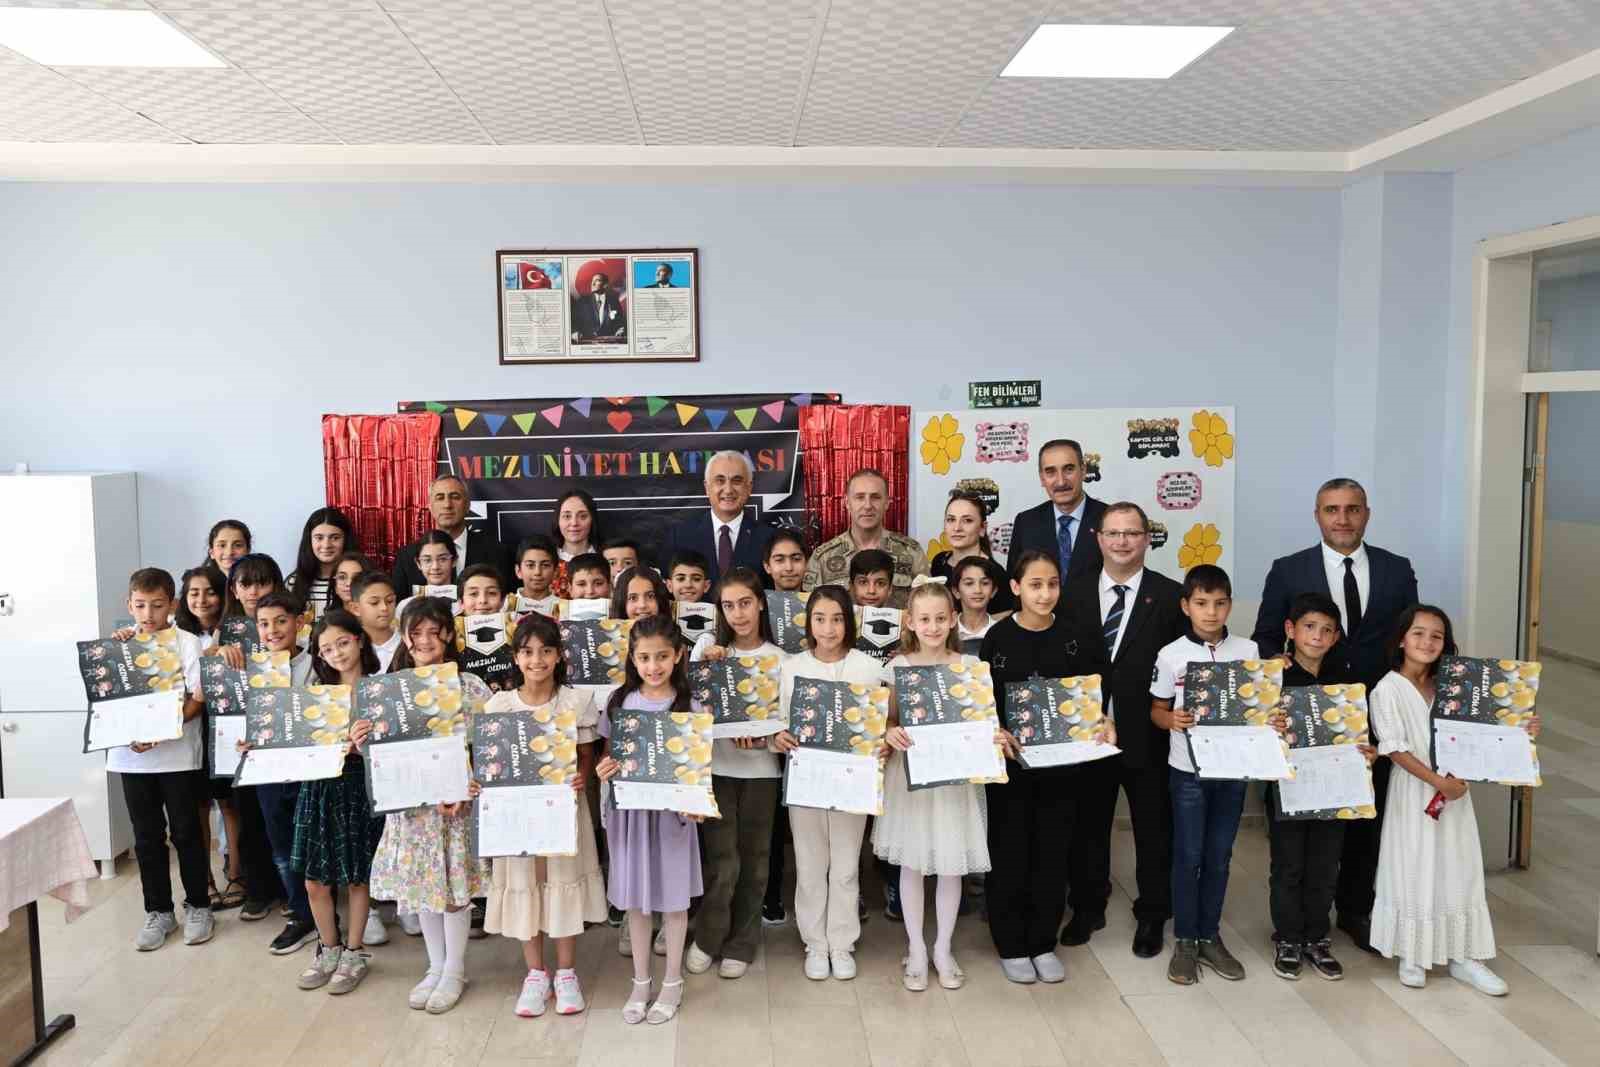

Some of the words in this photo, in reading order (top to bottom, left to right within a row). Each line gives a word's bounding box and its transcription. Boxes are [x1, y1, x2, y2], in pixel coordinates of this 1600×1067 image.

[974, 386, 990, 397] FEN
[992, 383, 1037, 396] BİLİMLERİ
[458, 447, 632, 478] MEZUNİYET
[639, 449, 785, 475] HATASI
[120, 642, 136, 671] MEZUN
[584, 627, 598, 660] MEZUN
[466, 656, 497, 669] MEZUN
[240, 670, 250, 692] EZUN
[398, 677, 415, 711] MEZUN
[725, 664, 737, 697] MEZUN
[935, 671, 950, 701] MEZUN
[1228, 668, 1237, 700] MEZUN
[1482, 665, 1491, 698] MEZUN
[292, 692, 302, 722] MEZUN
[834, 688, 843, 724] MEZUN
[1046, 686, 1059, 719] MEZUN
[1471, 686, 1480, 717] OLDUM
[517, 719, 529, 756] MEZUN
[655, 719, 665, 755] MEZUN
[510, 743, 522, 778] OLDUM
